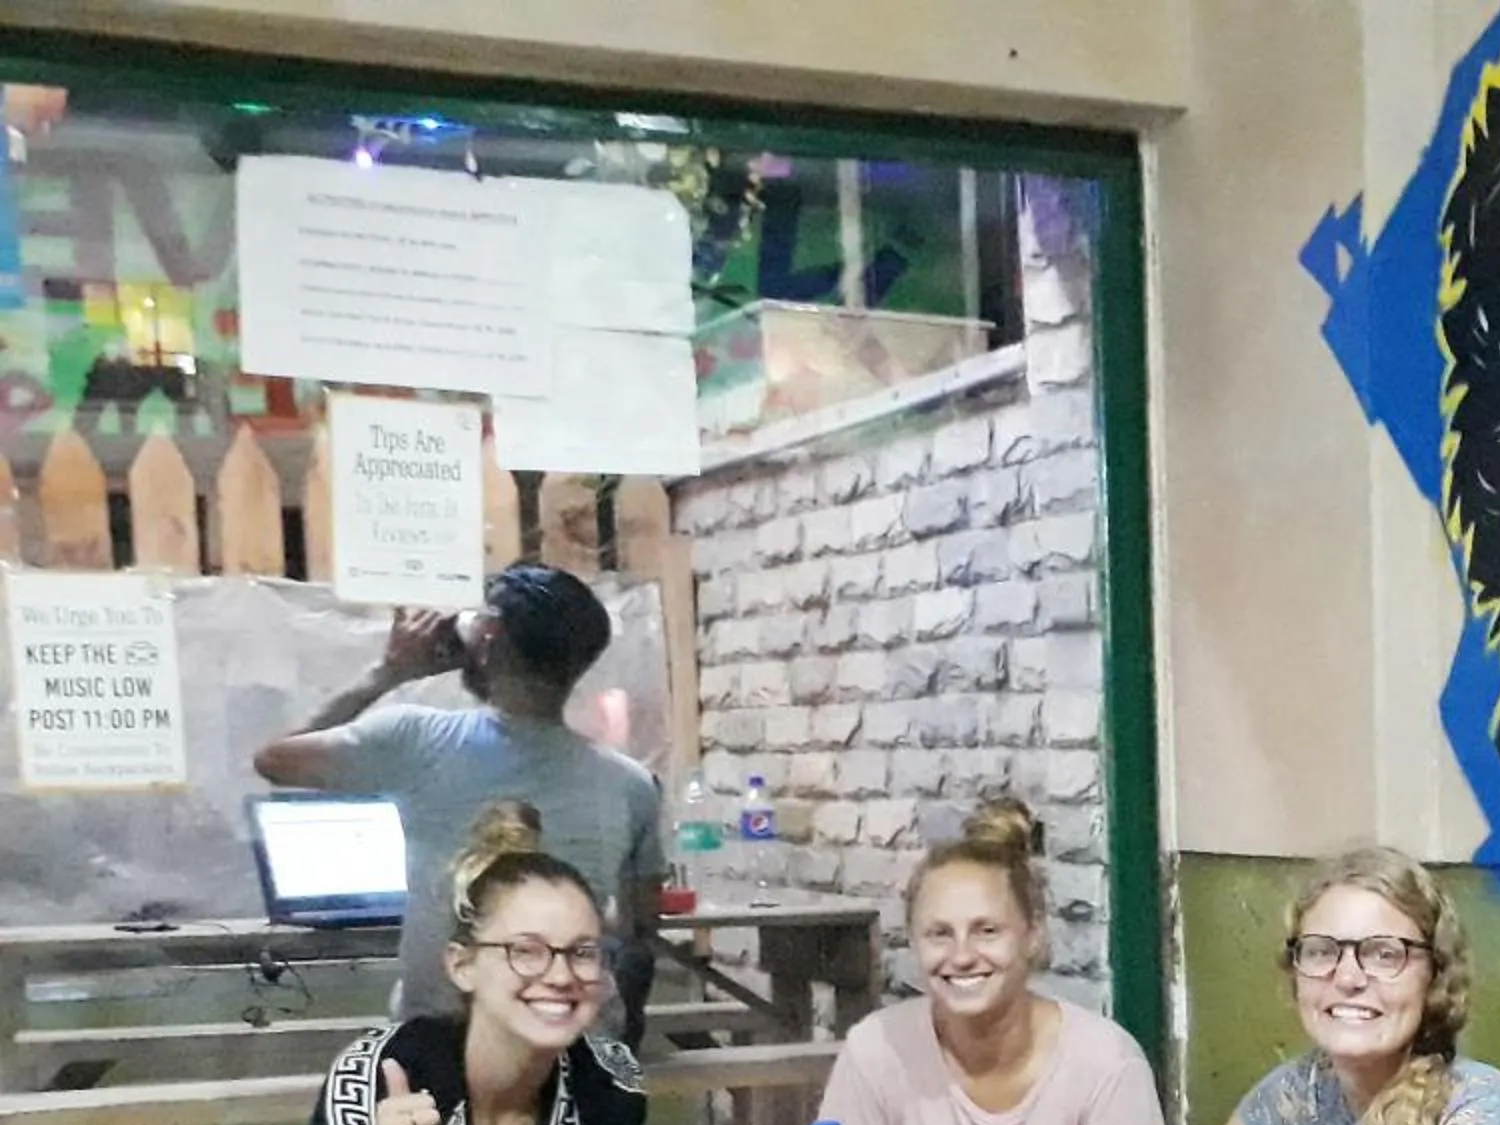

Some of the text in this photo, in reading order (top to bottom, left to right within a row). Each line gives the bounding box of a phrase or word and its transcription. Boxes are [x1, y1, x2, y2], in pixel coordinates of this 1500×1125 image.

[369, 424, 446, 453] Tips Are
[353, 452, 462, 481] Appreciated
[26, 643, 117, 665] KEEP THE
[45, 676, 152, 697] MUSIC LOW
[29, 709, 75, 730] POST
[142, 708, 172, 728] PM
